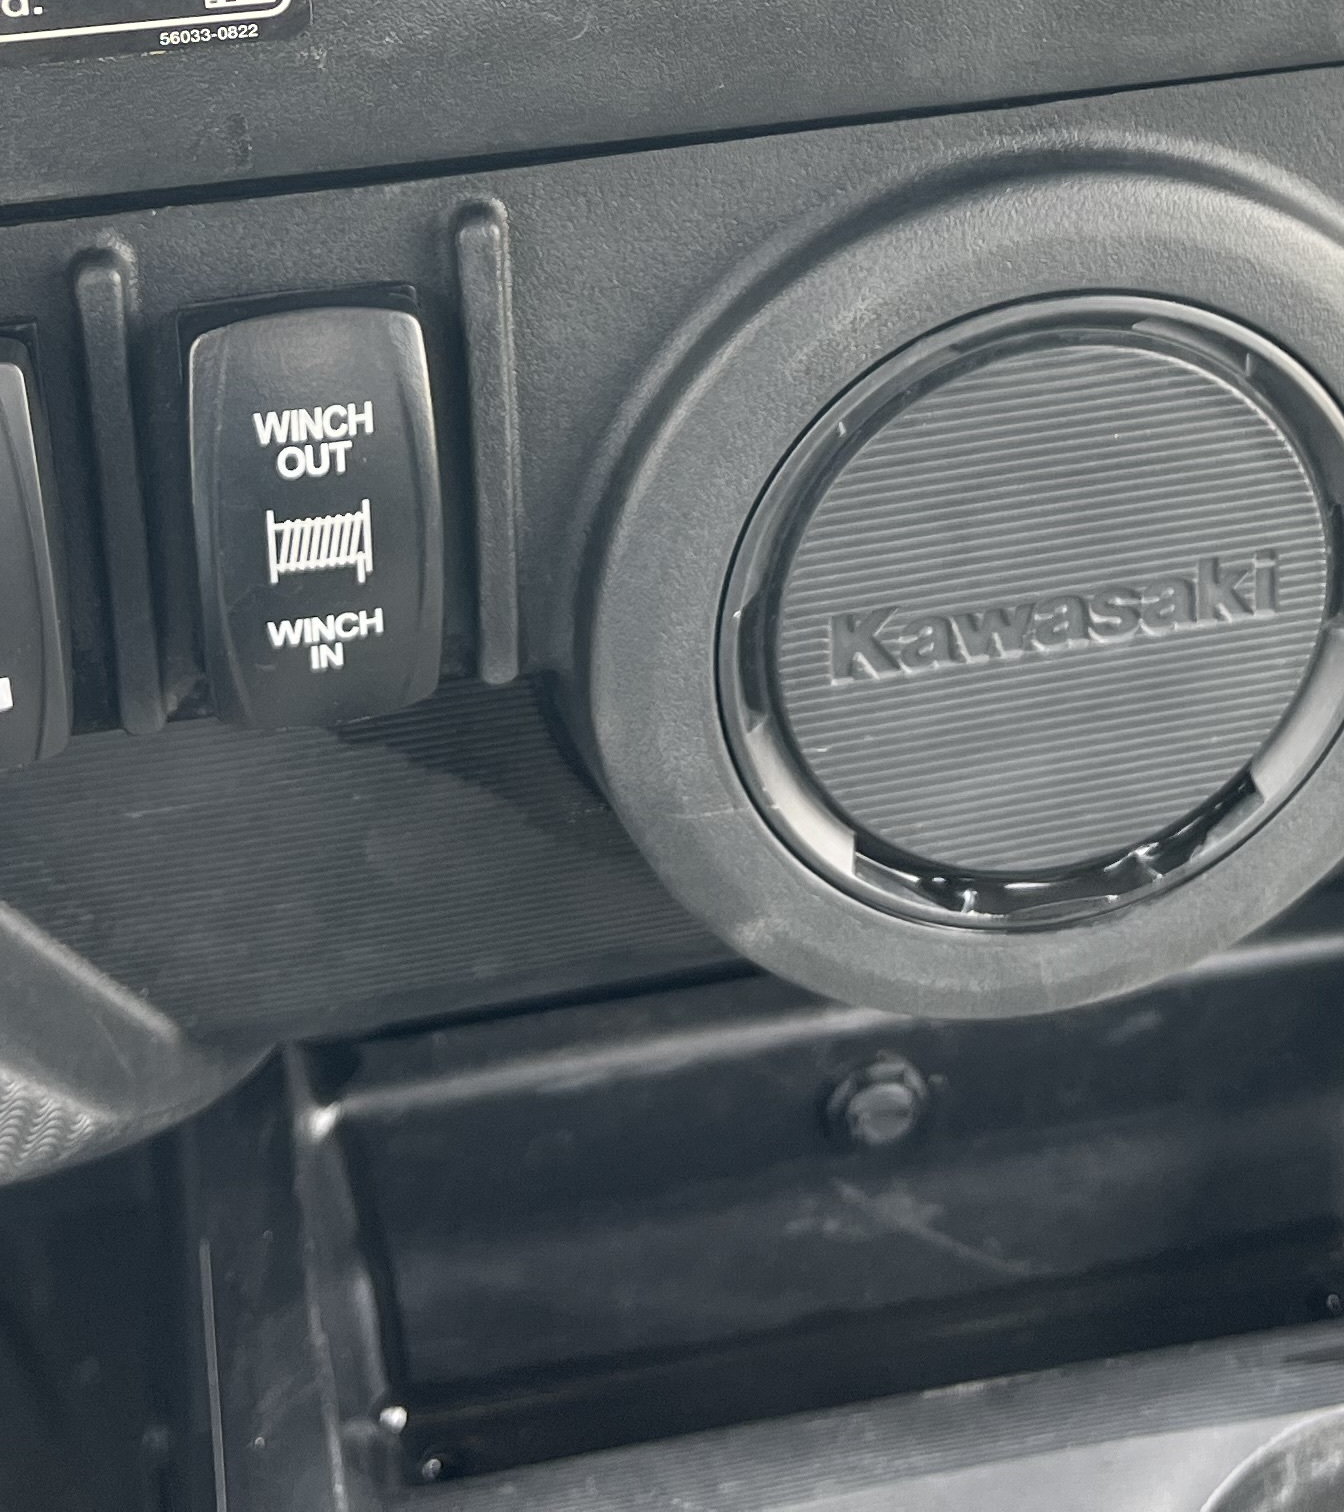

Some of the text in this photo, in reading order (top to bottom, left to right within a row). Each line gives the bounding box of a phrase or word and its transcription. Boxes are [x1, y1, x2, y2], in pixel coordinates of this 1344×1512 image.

[158, 23, 260, 48] 56033-0822
[253, 400, 374, 446] WINCH
[276, 439, 354, 480] OUT
[267, 607, 384, 649] WINCH
[826, 550, 1282, 686] Kawasaki
[309, 642, 346, 672] IN
